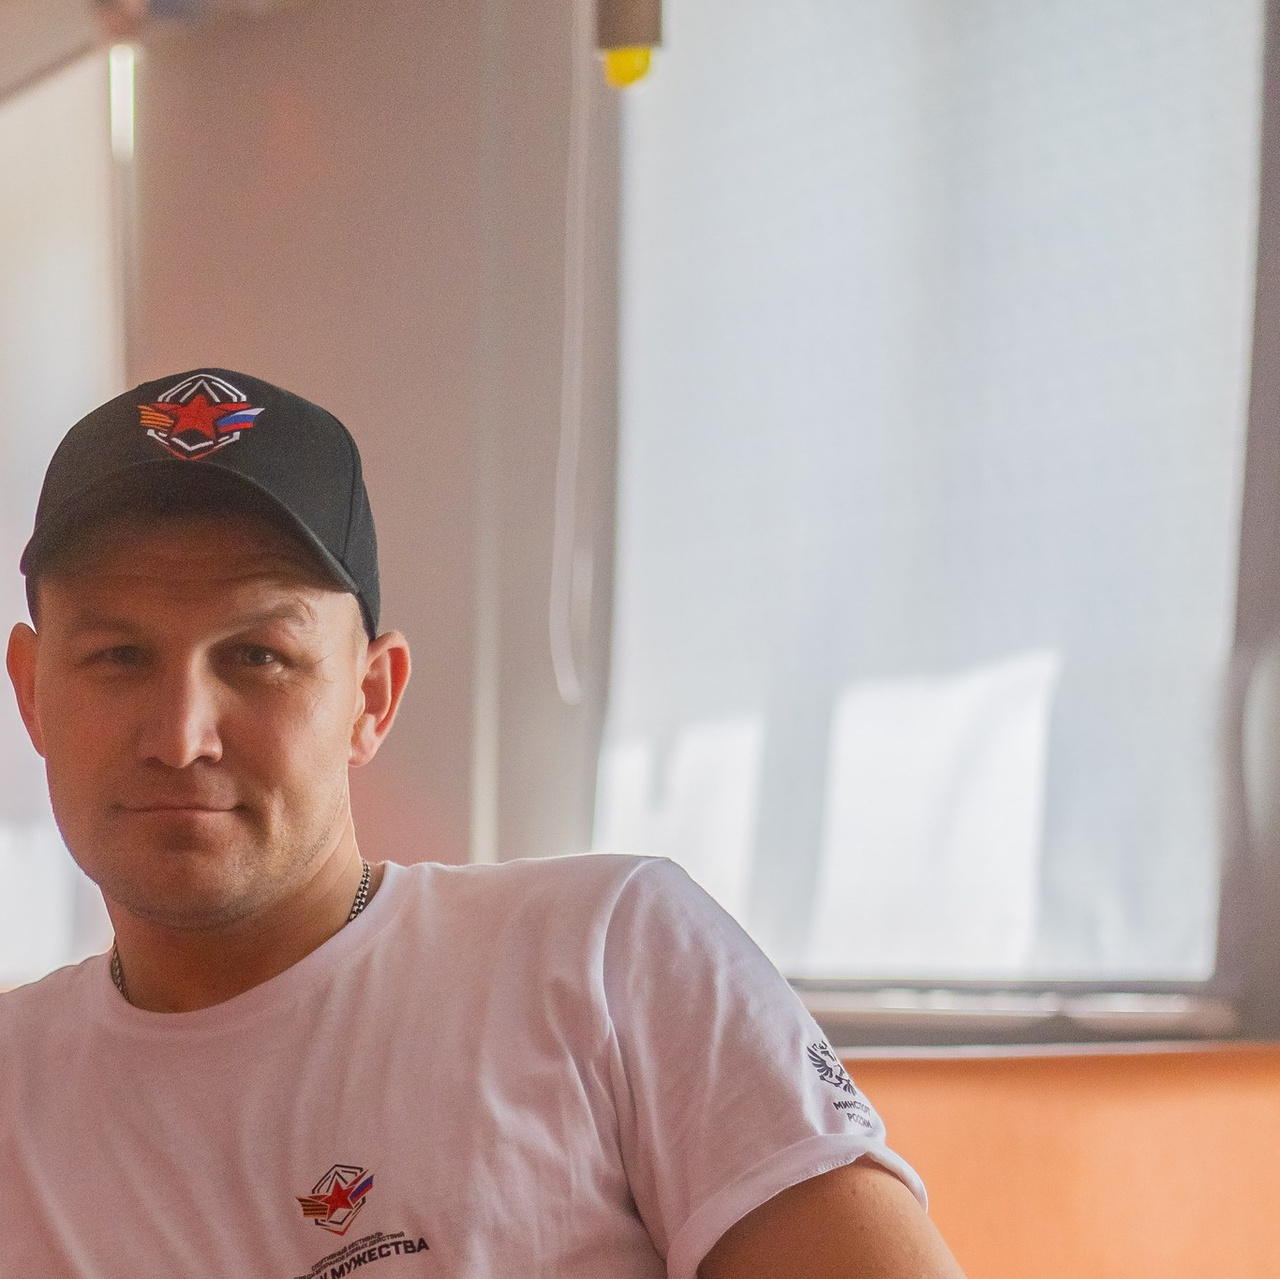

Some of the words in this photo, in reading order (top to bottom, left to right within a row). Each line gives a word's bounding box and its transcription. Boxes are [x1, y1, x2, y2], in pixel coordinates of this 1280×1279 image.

[311, 1246, 348, 1271] СПОРТИВНЫЙ
[348, 1231, 383, 1250] ФЕСТИВАЛЬ
[315, 1255, 346, 1276] ВЕТЕРАНОВ
[369, 1231, 405, 1247] ДЕЙСТВИЙ
